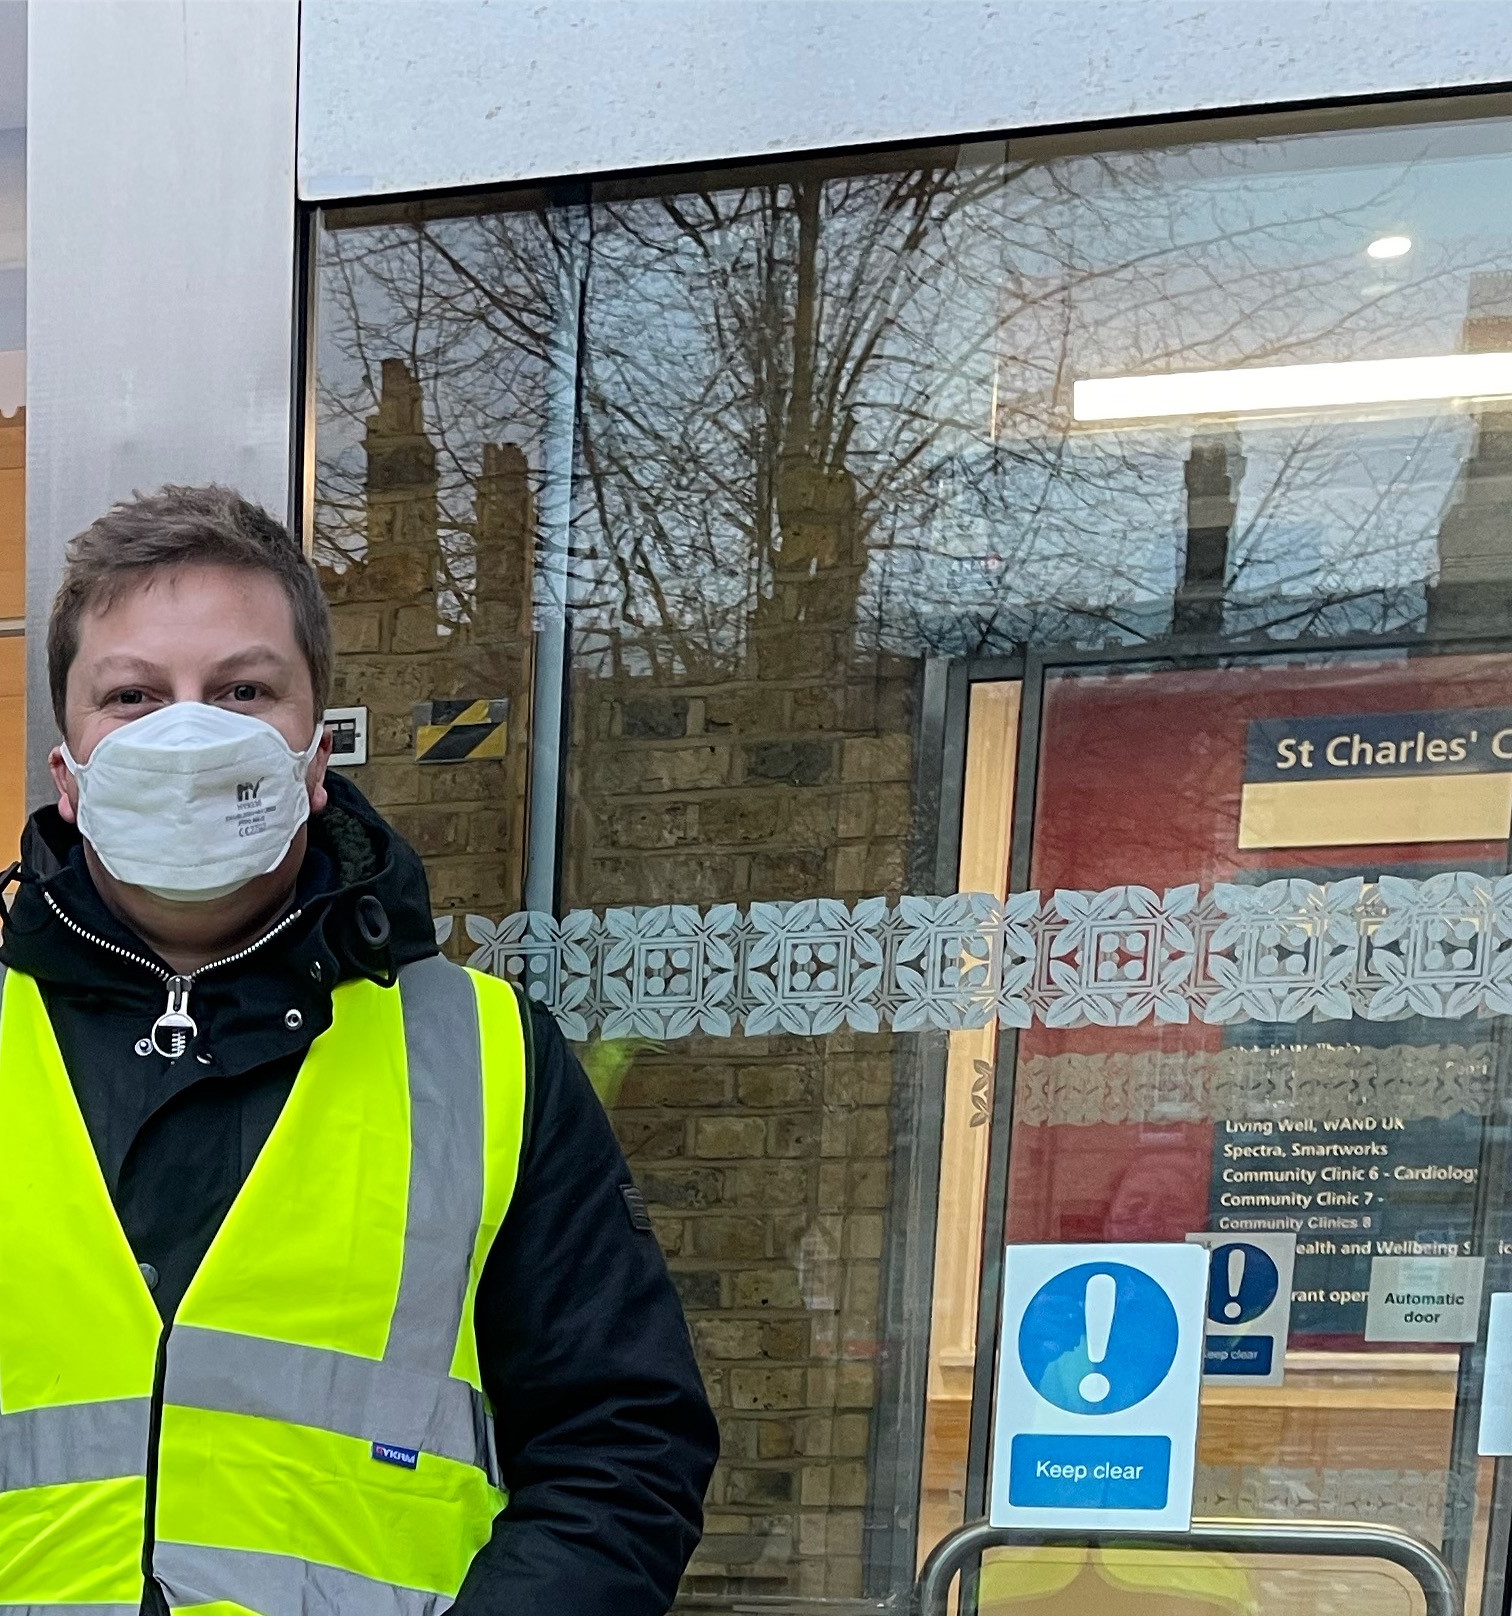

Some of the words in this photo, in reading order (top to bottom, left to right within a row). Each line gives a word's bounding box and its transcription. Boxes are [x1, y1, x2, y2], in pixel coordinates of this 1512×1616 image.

[1276, 738, 1314, 769] St
[1326, 730, 1478, 767] Charles'
[1225, 1118, 1273, 1135] Living
[1277, 1117, 1317, 1134] Well,
[1223, 1143, 1286, 1160] Spectra,
[1291, 1141, 1388, 1157] Smartworks
[1222, 1167, 1317, 1185] Community
[1320, 1165, 1365, 1181] Clinic
[1369, 1165, 1379, 1180] 6
[1220, 1191, 1312, 1209] Community
[1316, 1190, 1359, 1206] Clinic
[1363, 1191, 1373, 1205] 7
[1219, 1216, 1303, 1233] Community
[1307, 1215, 1358, 1229] Clinics
[1296, 1241, 1336, 1255] ealth
[1341, 1241, 1372, 1255] and
[1376, 1240, 1459, 1257] Wellbeing
[1291, 1290, 1325, 1302] rant
[1384, 1293, 1464, 1306] Automatic
[1404, 1310, 1441, 1324] door
[1205, 1351, 1229, 1361] eep
[1036, 1460, 1087, 1482] Keep
[1093, 1461, 1143, 1479] clear
